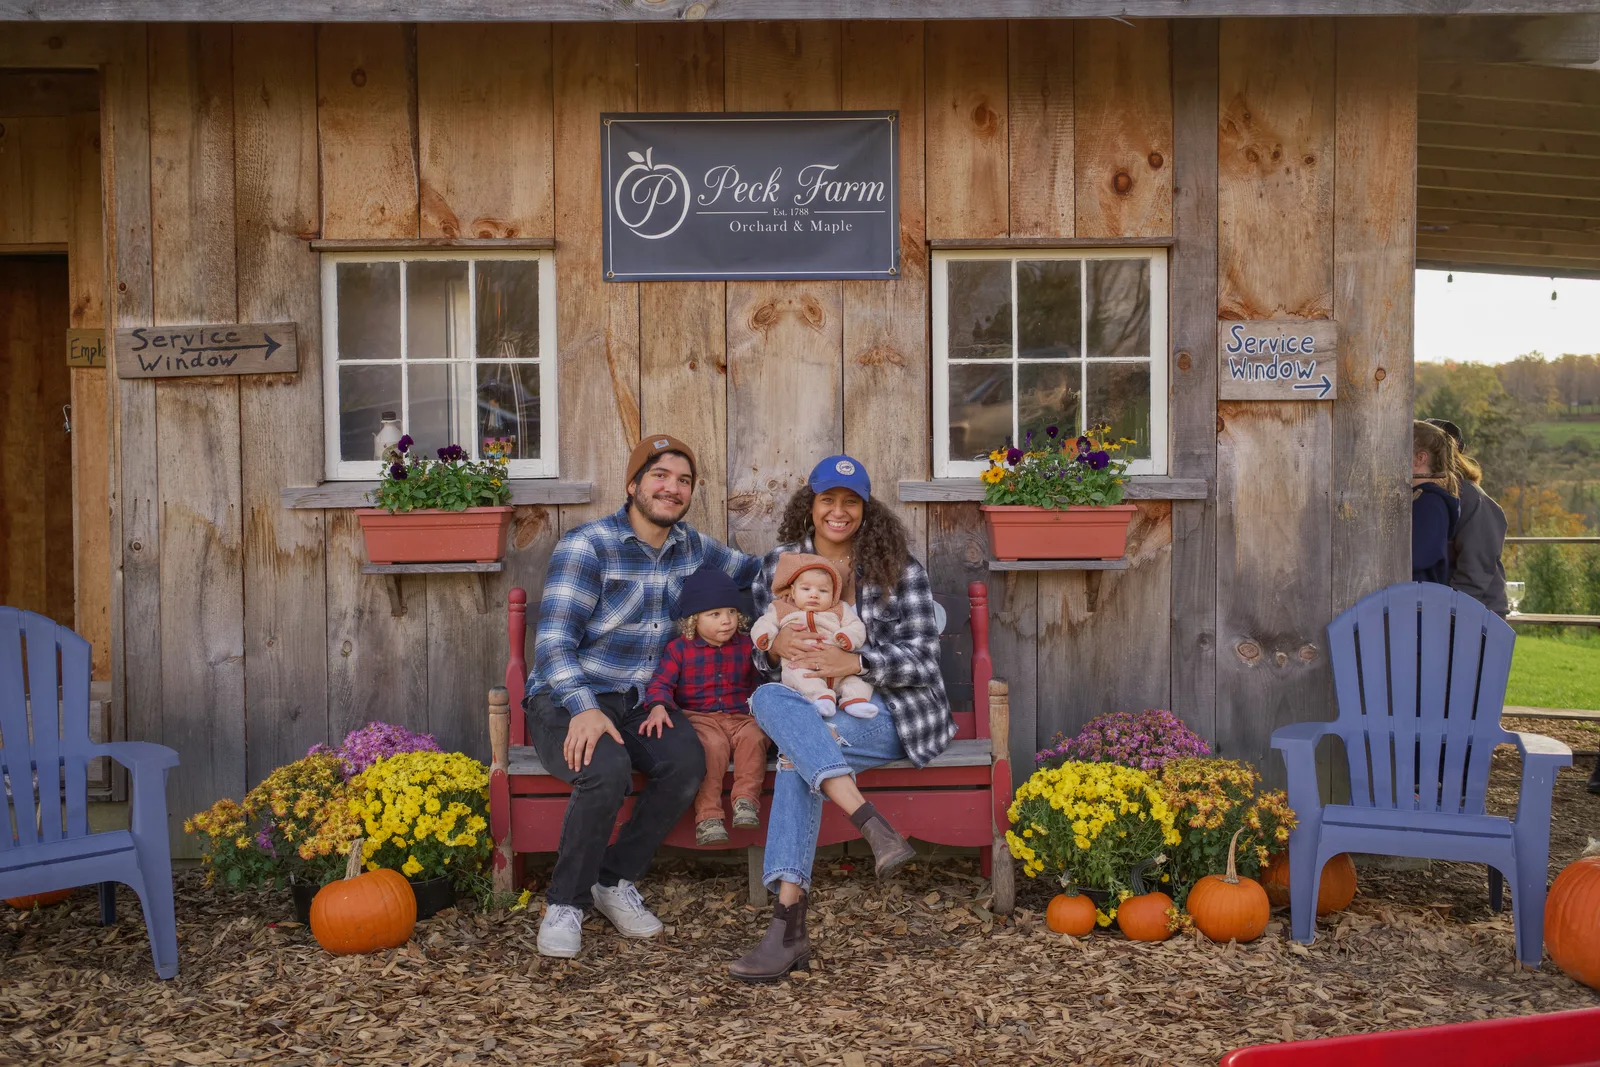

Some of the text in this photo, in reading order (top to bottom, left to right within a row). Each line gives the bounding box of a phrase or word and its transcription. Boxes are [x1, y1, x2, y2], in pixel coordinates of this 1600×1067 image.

[697, 164, 886, 206] Peck Farm
[773, 207, 809, 216] Est. 1788
[729, 219, 853, 234] Orchard & Maple
[131, 327, 241, 351] Service
[1226, 324, 1315, 354] Service
[137, 351, 238, 372] Window
[1229, 354, 1316, 380] Window
